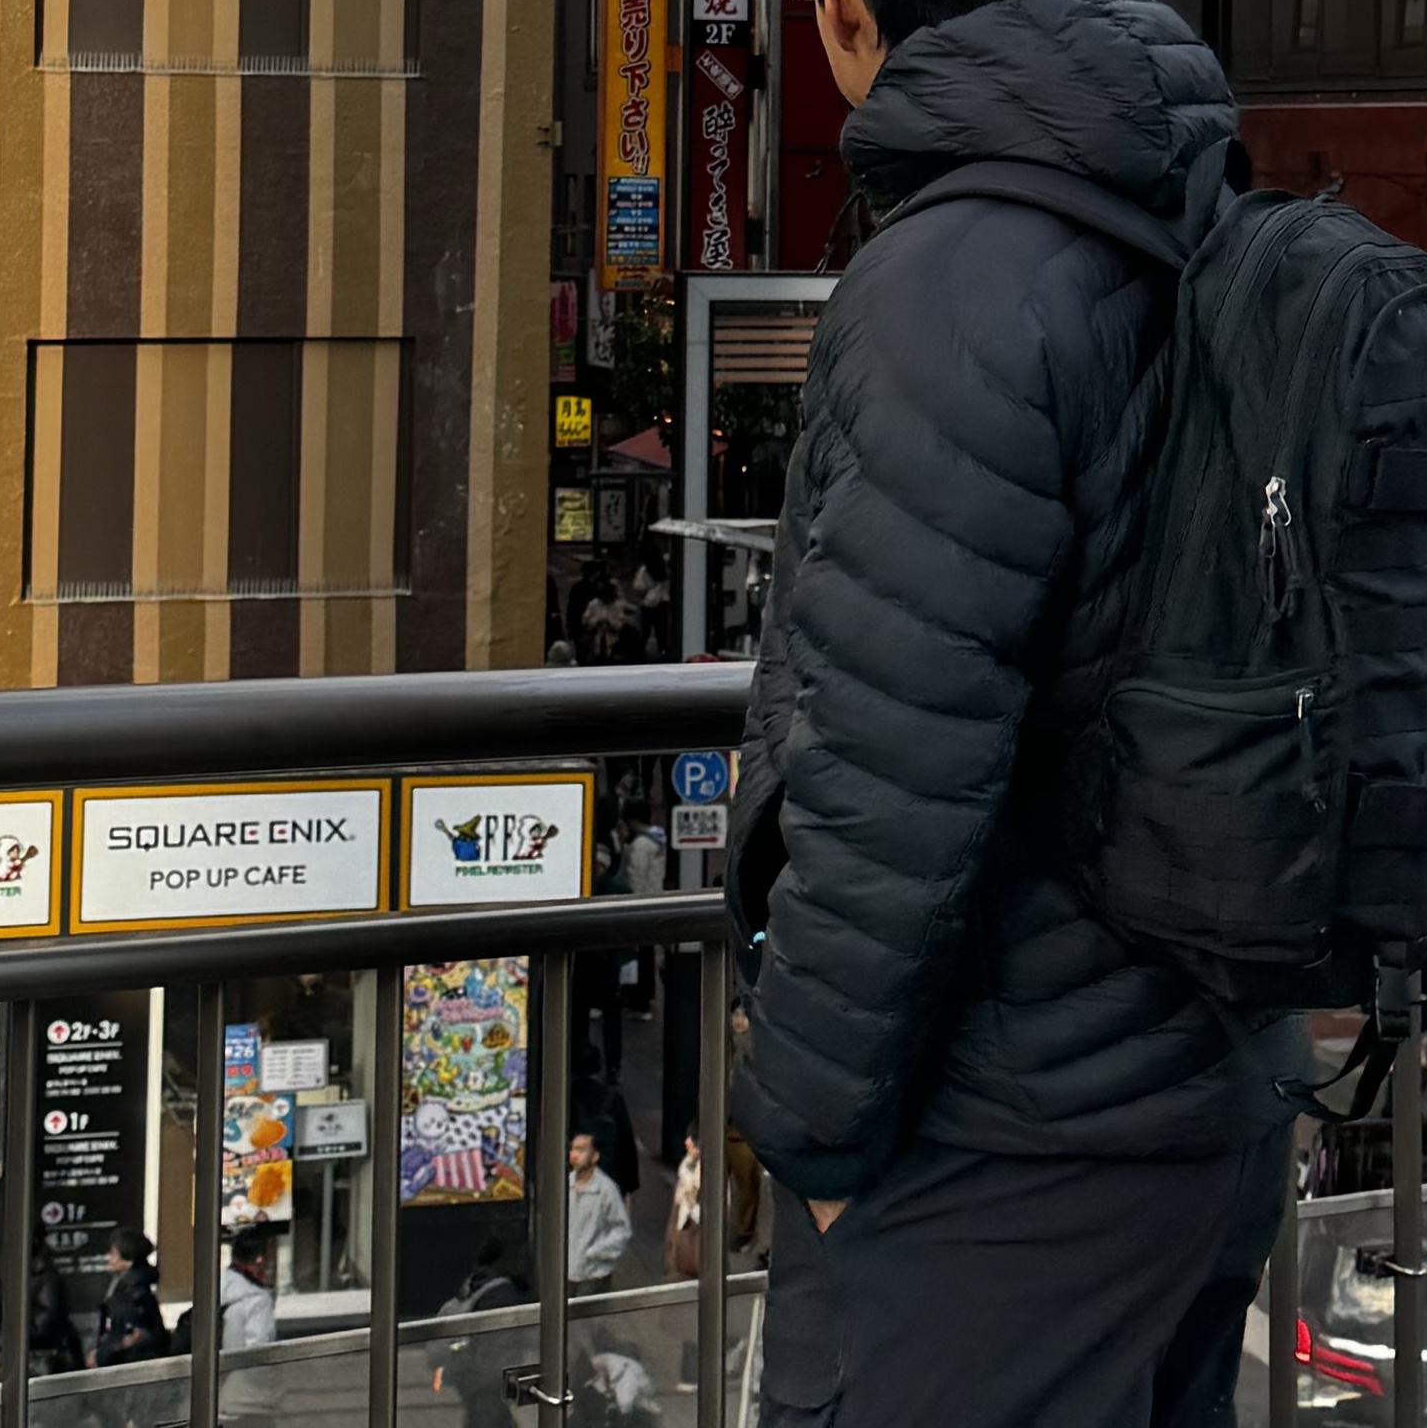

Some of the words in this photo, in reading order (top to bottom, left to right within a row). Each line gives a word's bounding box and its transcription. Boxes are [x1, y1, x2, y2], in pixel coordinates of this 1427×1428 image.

[706, 24, 736, 46] 2F
[108, 822, 259, 852] SQUARE
[269, 817, 355, 844] ENIX
[150, 870, 200, 890] POP
[207, 869, 238, 887] UP
[244, 865, 307, 886] CAFE
